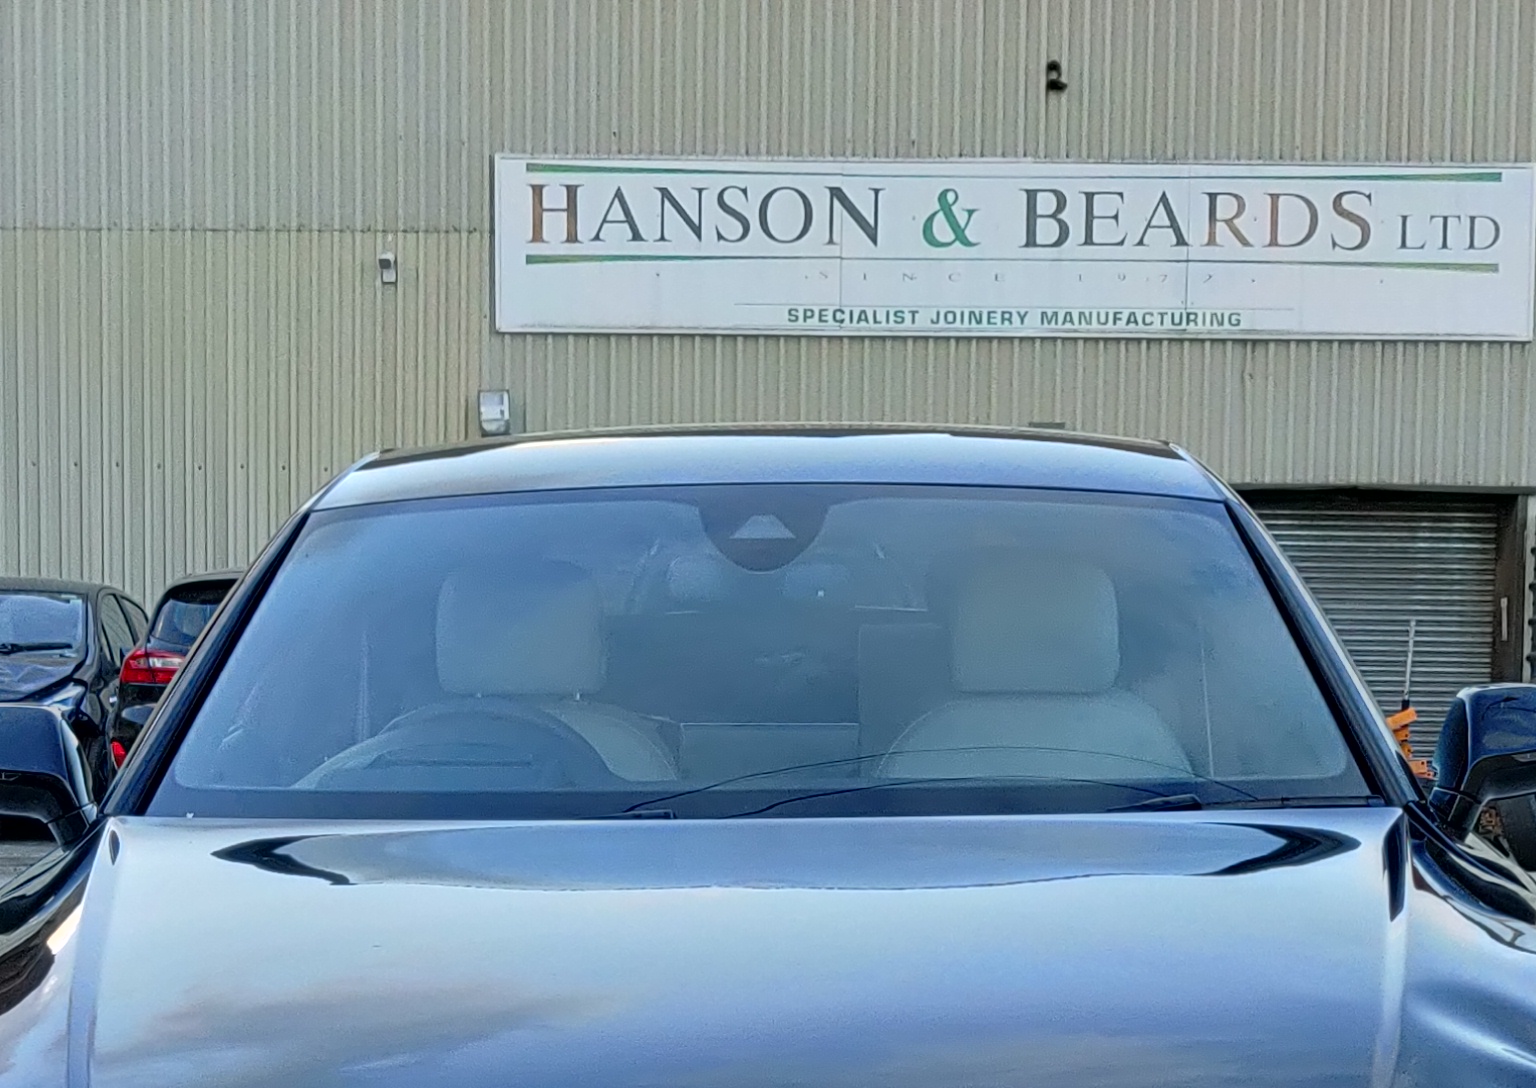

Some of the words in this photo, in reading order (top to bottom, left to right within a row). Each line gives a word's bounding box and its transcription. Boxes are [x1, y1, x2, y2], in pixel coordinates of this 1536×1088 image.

[526, 183, 886, 247] HANSON
[922, 187, 981, 248] &
[1018, 188, 1373, 251] BEARDS
[1396, 214, 1501, 251] LTD
[787, 307, 920, 326] SPECIALIST
[930, 309, 1029, 326] JOINERY
[1040, 310, 1242, 328] MANUFACTURING
